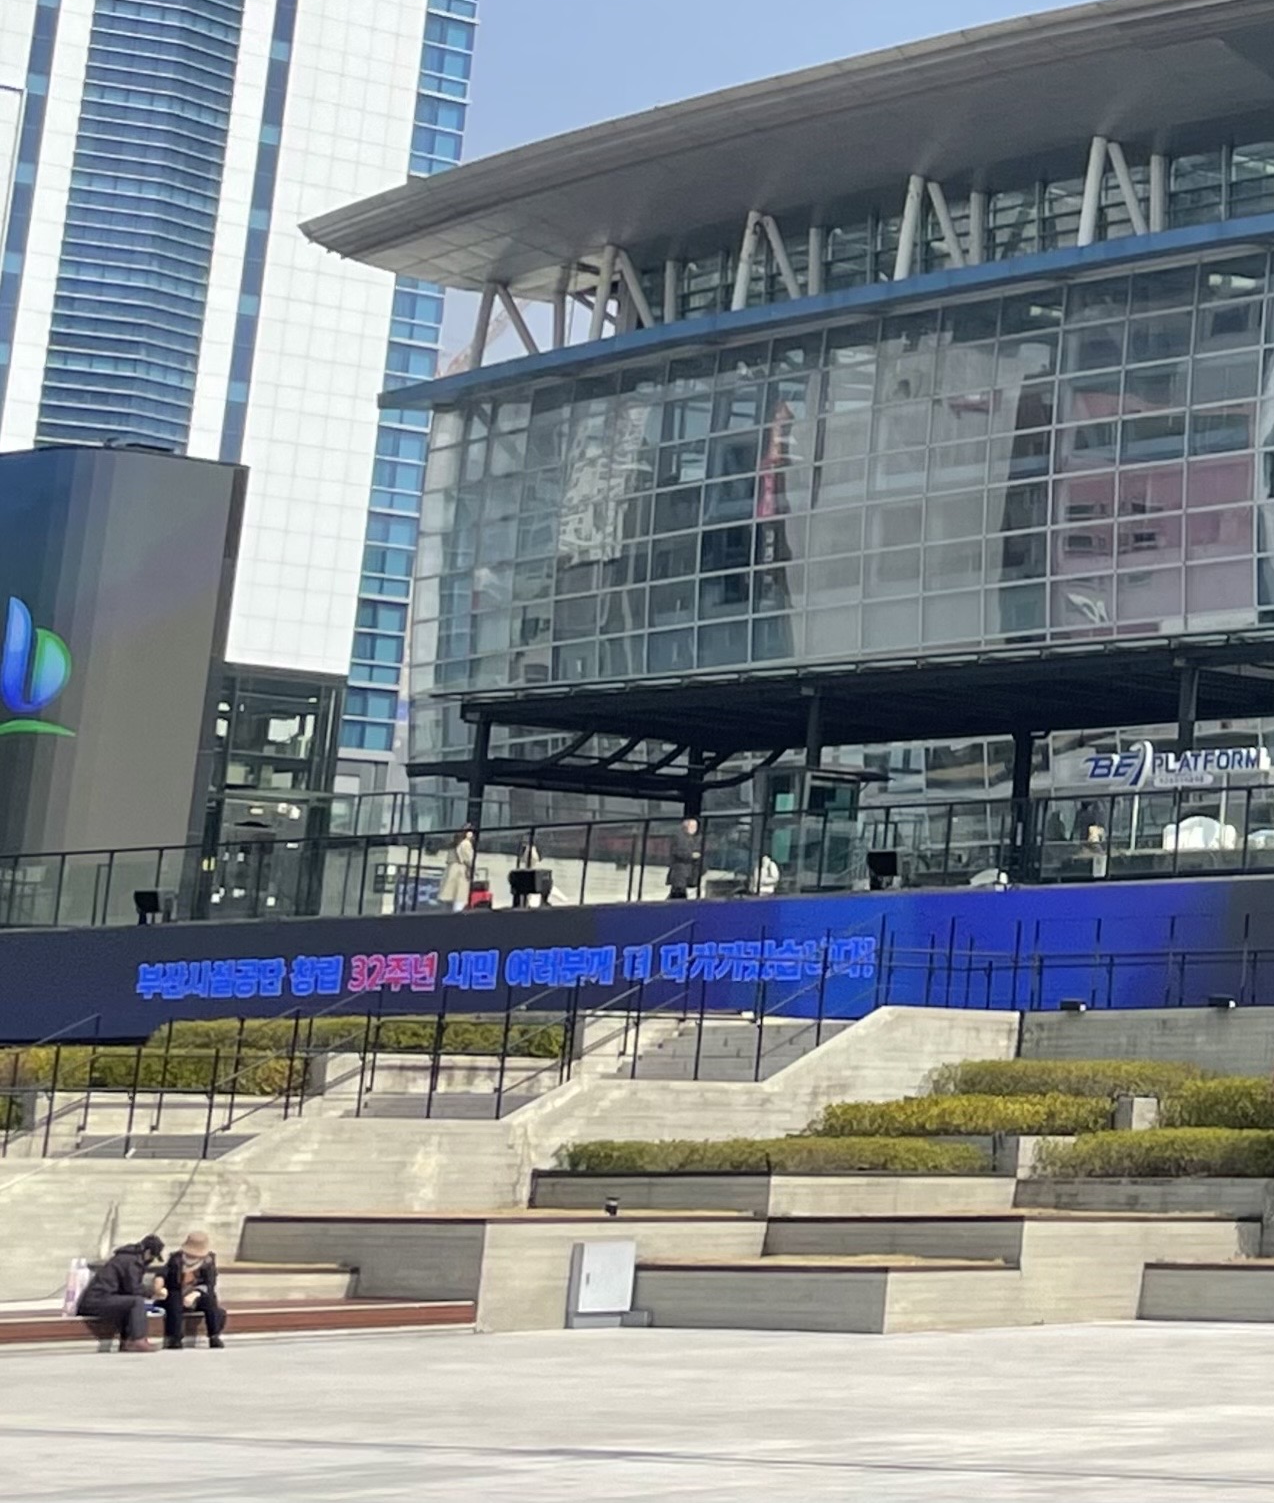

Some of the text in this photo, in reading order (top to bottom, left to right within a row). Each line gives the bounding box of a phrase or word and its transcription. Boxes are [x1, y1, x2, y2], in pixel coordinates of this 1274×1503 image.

[1151, 747, 1261, 773] PLATFORM
[136, 957, 286, 999] 부산시설공단
[290, 954, 344, 996] 창립
[347, 951, 438, 992] 32주년
[442, 949, 499, 990] 시민
